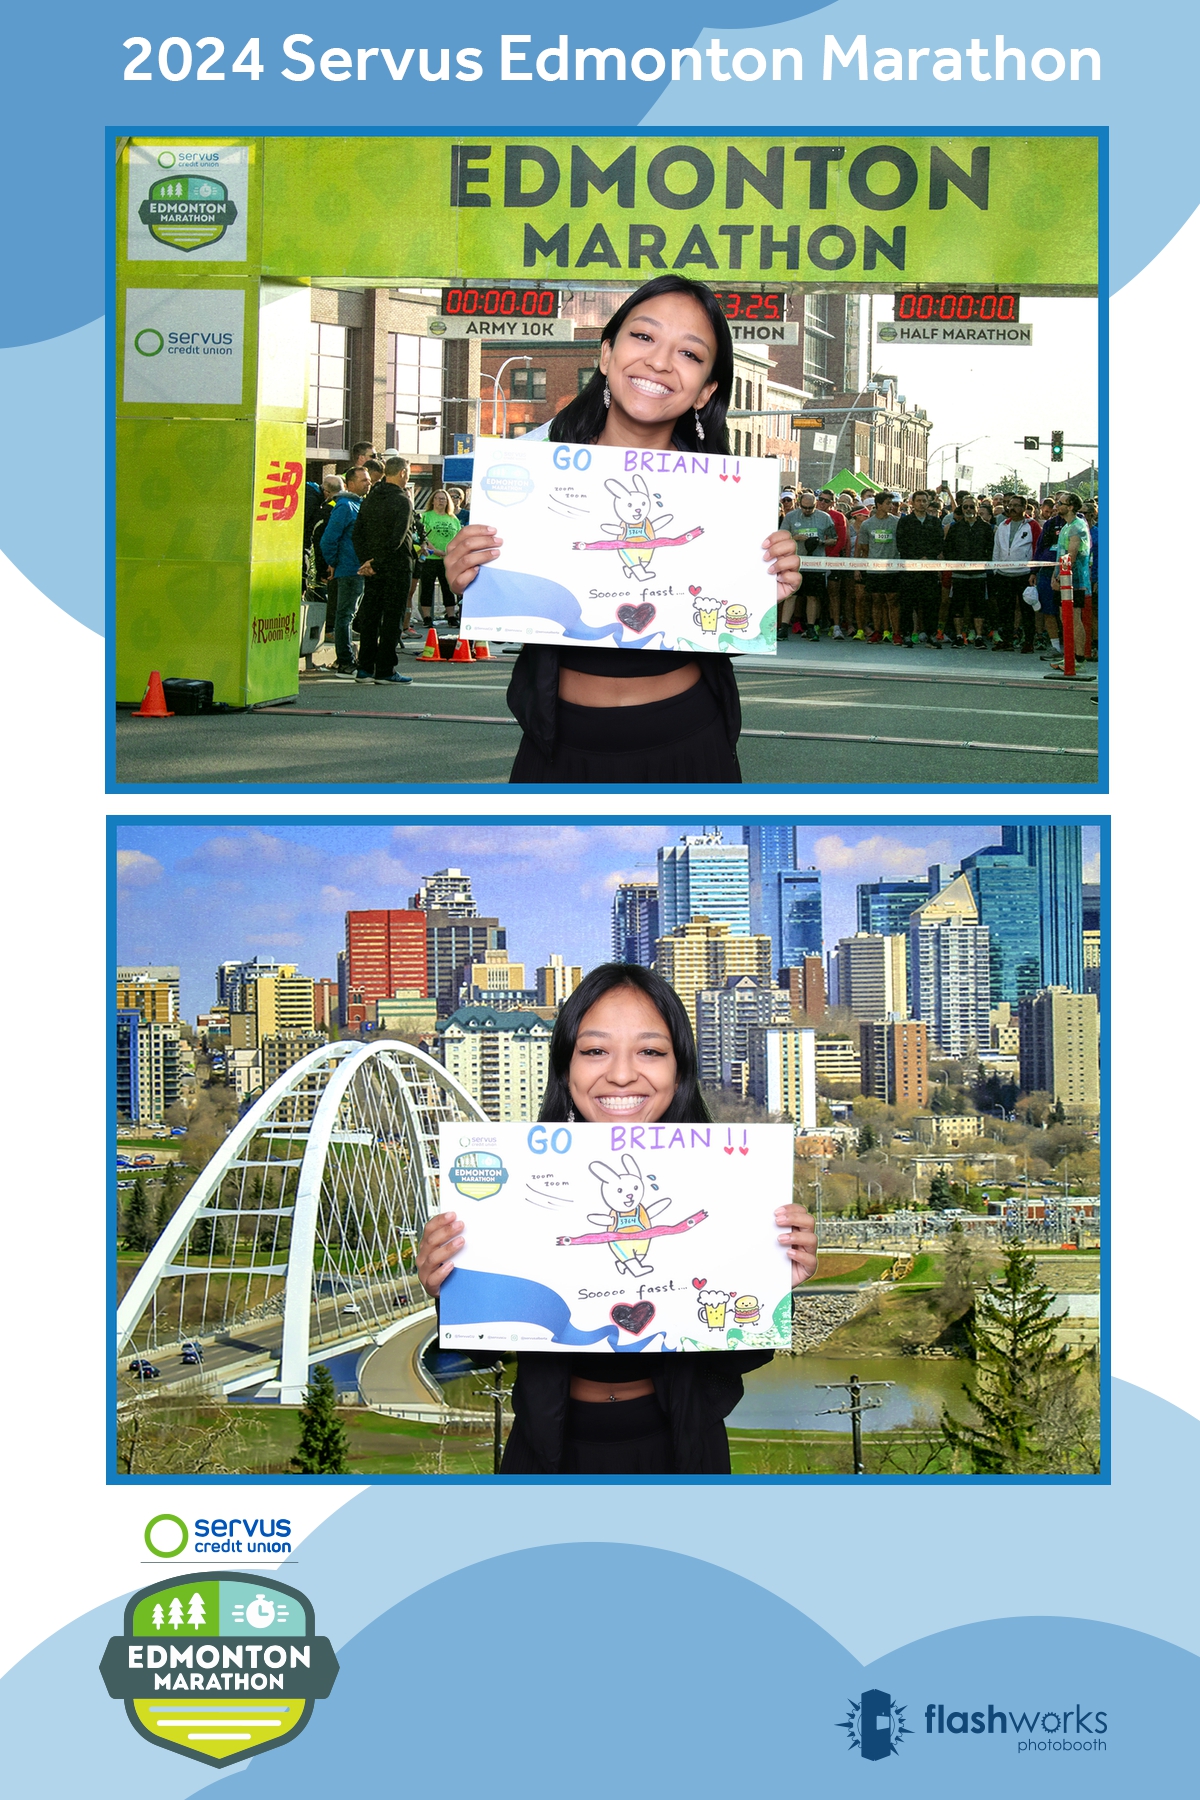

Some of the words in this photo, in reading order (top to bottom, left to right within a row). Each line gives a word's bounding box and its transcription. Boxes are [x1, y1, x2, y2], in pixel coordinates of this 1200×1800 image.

[178, 152, 220, 161] servus
[450, 144, 989, 211] EDMONTON
[149, 202, 227, 214] EDMONTON
[160, 214, 215, 222] MARATHON
[523, 222, 906, 271] MARATHON
[465, 321, 517, 336] ARMY
[522, 322, 555, 336] 10K
[900, 327, 939, 340] HALF
[943, 328, 1031, 341] MARATHON
[168, 332, 233, 345] servus
[168, 345, 200, 355] credit
[203, 347, 233, 355] union
[553, 444, 592, 471] GO
[624, 450, 709, 474] BRIAN
[486, 478, 530, 487] EDMONTON
[257, 613, 291, 644] Running
[527, 1125, 573, 1155] GO
[610, 1125, 711, 1151] BRIAN
[454, 1168, 502, 1177] EDMONTON
